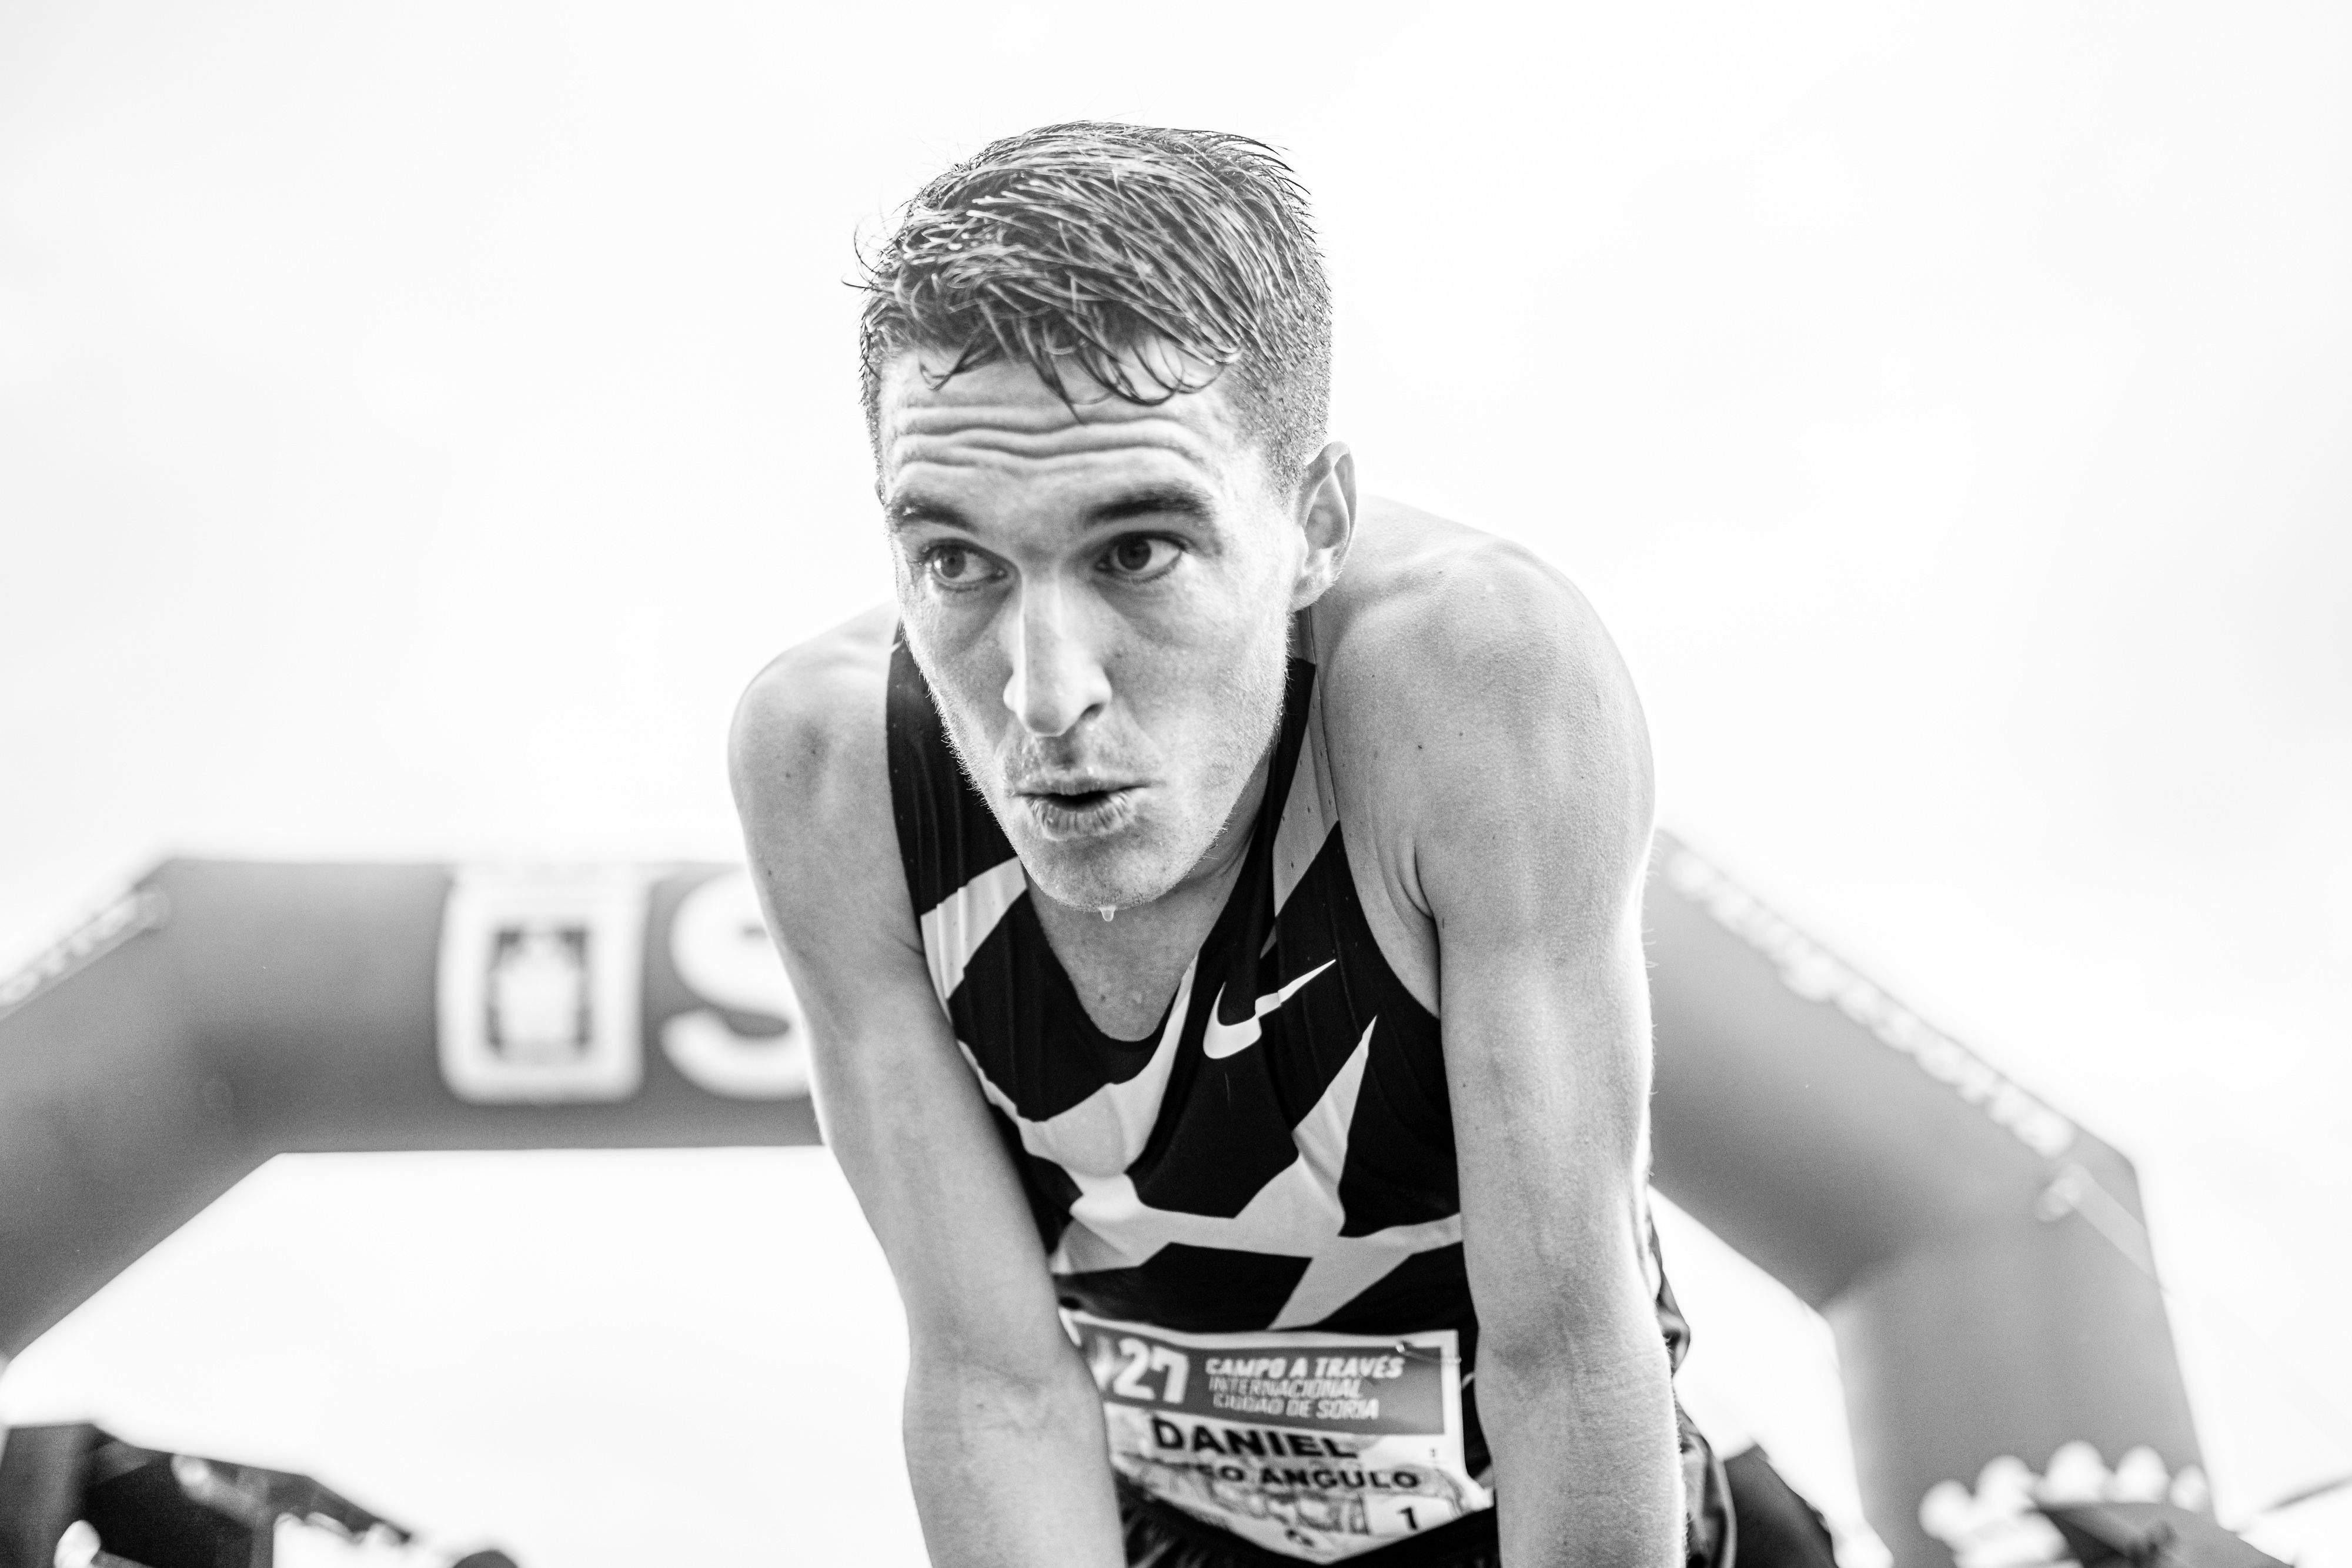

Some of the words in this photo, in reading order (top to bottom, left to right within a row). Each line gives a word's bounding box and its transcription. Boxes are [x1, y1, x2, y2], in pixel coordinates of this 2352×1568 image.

[1206, 1357, 1287, 1379] CAMPO
[1289, 1357, 1308, 1378] A
[1314, 1355, 1405, 1379] TRAVÉS
[1208, 1376, 1362, 1398] INTERNACIONAL
[1213, 1392, 1284, 1415] CIUDAD
[1285, 1399, 1309, 1418] DE
[1315, 1398, 1379, 1420] SORIA
[1151, 1415, 1358, 1459] DANIEL
[1261, 1466, 1418, 1489] ANGULO
[1396, 1506, 1418, 1531] 1
